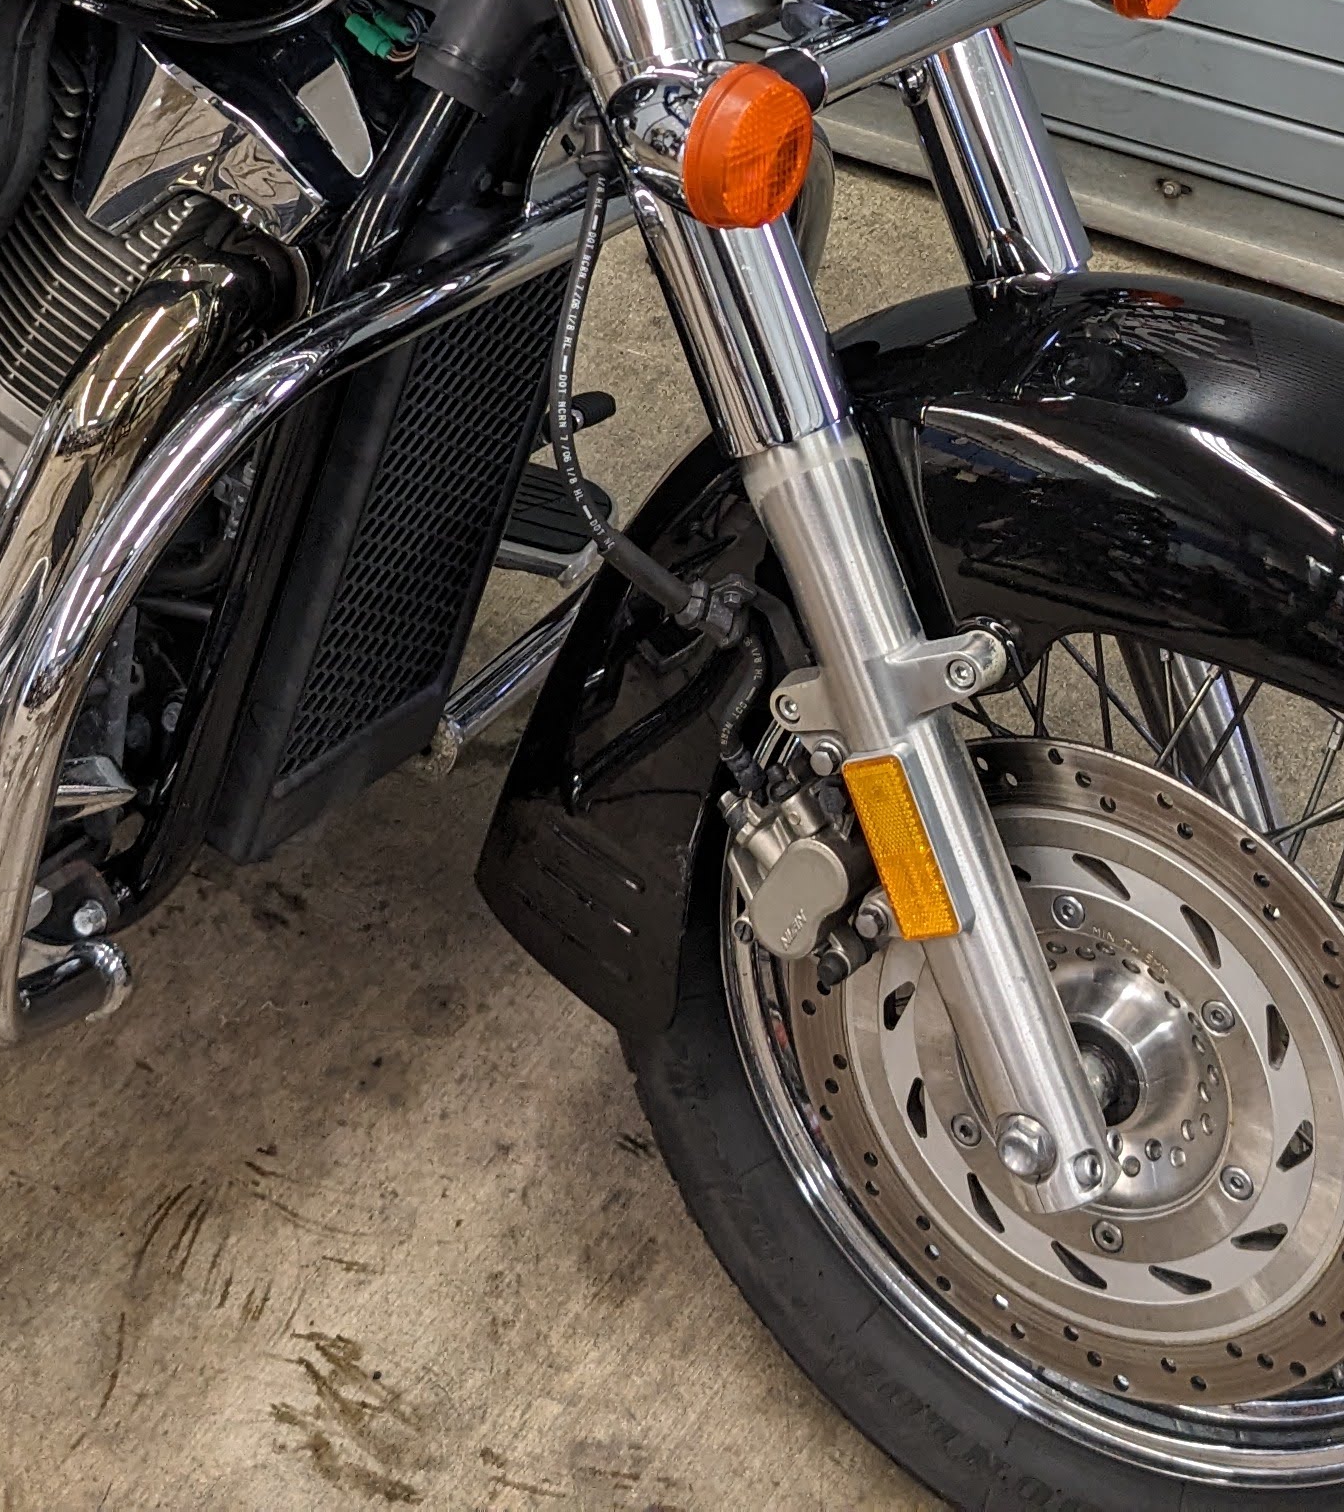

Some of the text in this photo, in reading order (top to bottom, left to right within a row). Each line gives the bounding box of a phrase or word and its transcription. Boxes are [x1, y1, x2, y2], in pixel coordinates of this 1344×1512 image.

[585, 231, 597, 250] DOT
[557, 374, 568, 394] DOT
[566, 466, 578, 485] 1/8
[573, 488, 585, 502] HL
[589, 519, 605, 536] DOT
